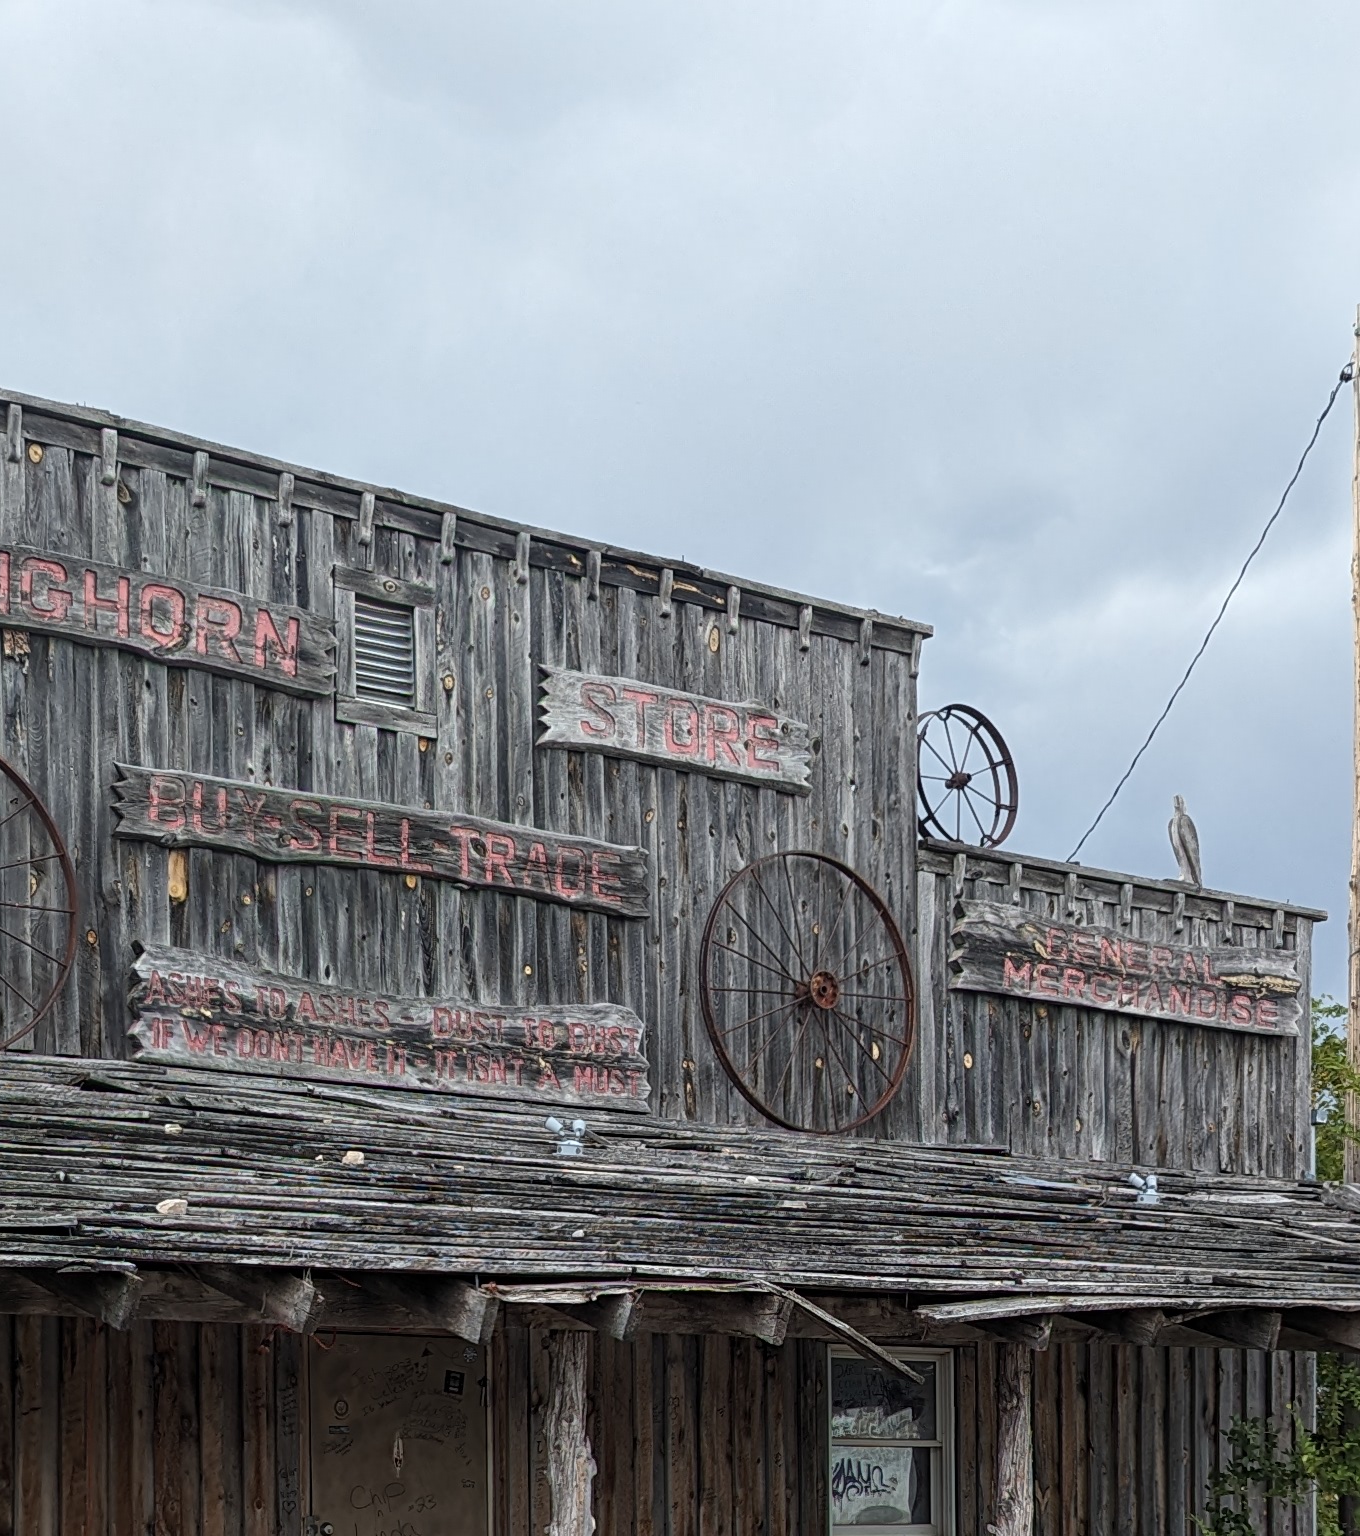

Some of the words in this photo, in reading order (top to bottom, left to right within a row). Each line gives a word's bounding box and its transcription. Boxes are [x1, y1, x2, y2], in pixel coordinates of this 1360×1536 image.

[580, 682, 779, 772] STORE
[1003, 956, 1280, 1029] MERCHANDISE
[1045, 927, 1224, 987] GENERAL
[144, 970, 243, 1015] ASHES
[253, 984, 288, 1018] TO
[296, 991, 391, 1030] ASHES
[432, 1007, 507, 1043] DUST
[524, 1018, 555, 1049] TO
[568, 1022, 640, 1055] DUST
[151, 1017, 174, 1050] IF
[181, 1020, 228, 1056] WE
[313, 1034, 380, 1073] HAVE
[386, 1045, 408, 1076] IT
[435, 1050, 457, 1080] IT
[537, 1057, 562, 1089] A
[574, 1065, 642, 1097] MUST
